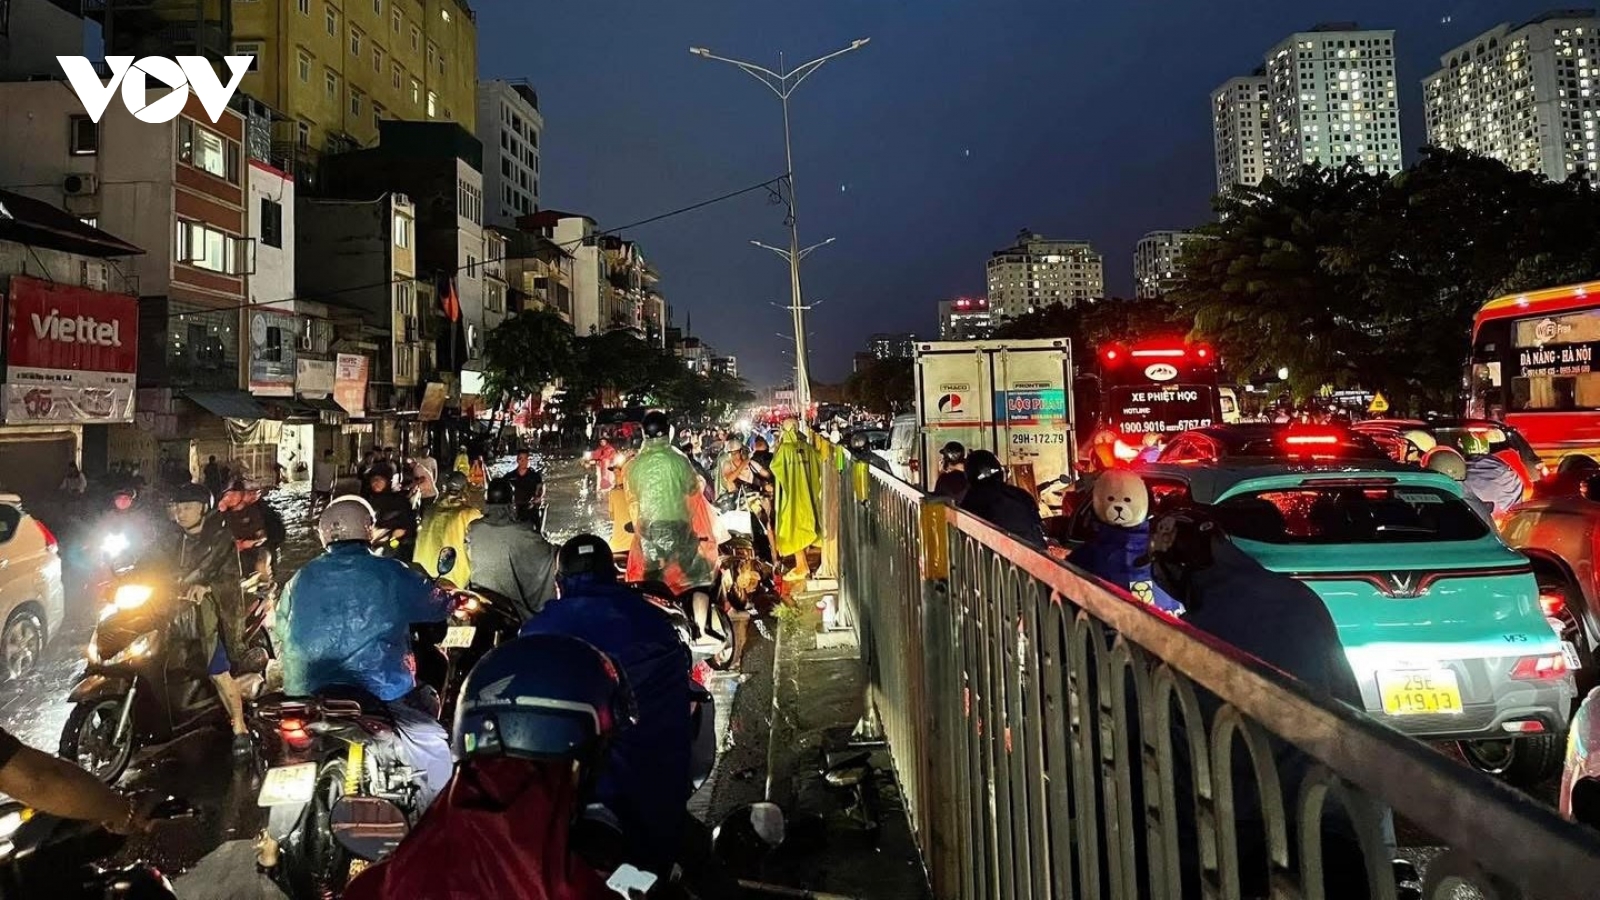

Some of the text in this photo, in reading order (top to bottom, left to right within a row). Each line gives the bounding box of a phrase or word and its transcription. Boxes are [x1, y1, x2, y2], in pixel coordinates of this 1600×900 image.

[1562, 346, 1574, 362] HÀ
[1576, 344, 1592, 364] NỘI
[1131, 390, 1198, 403] XE PHIỆT HỌC
[1009, 396, 1031, 413] LỘC
[1120, 421, 1165, 433] 1900.9016
[1013, 433, 1064, 444] 29H-172.79
[1393, 692, 1452, 712] 119.13
